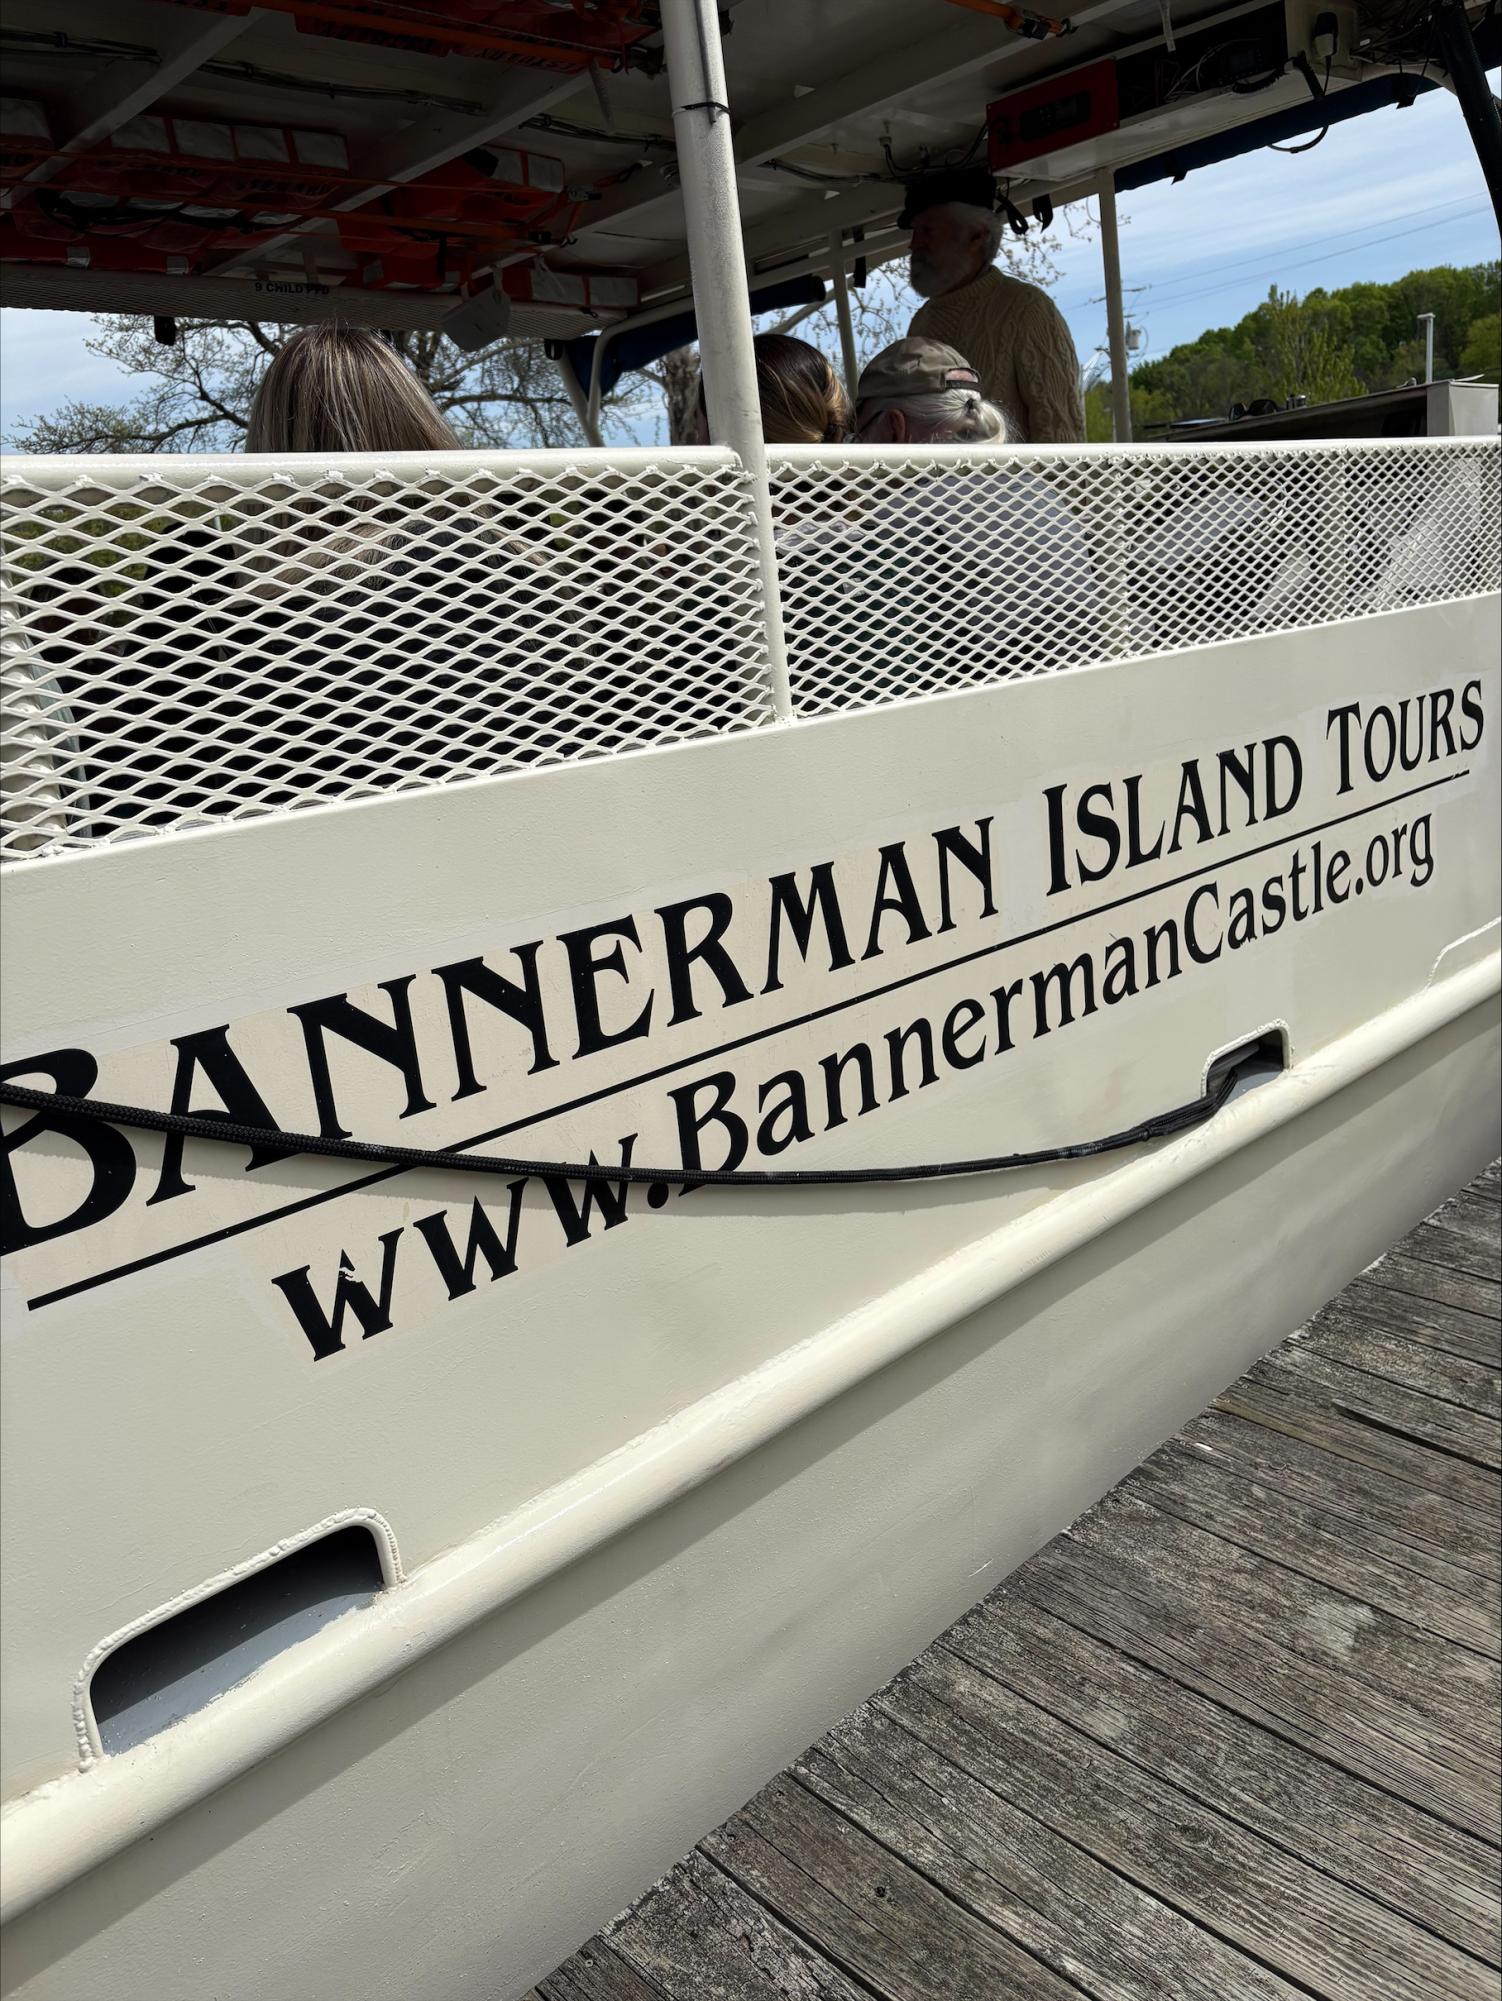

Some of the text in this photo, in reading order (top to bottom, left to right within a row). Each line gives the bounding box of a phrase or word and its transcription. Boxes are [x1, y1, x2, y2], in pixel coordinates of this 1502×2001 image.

[255, 282, 263, 292] 9
[266, 283, 303, 294] CHILD
[0, 680, 1485, 1256] BANNERMAN ISLAND TOURS
[272, 813, 1434, 1362] www.BannermanCastle.org
